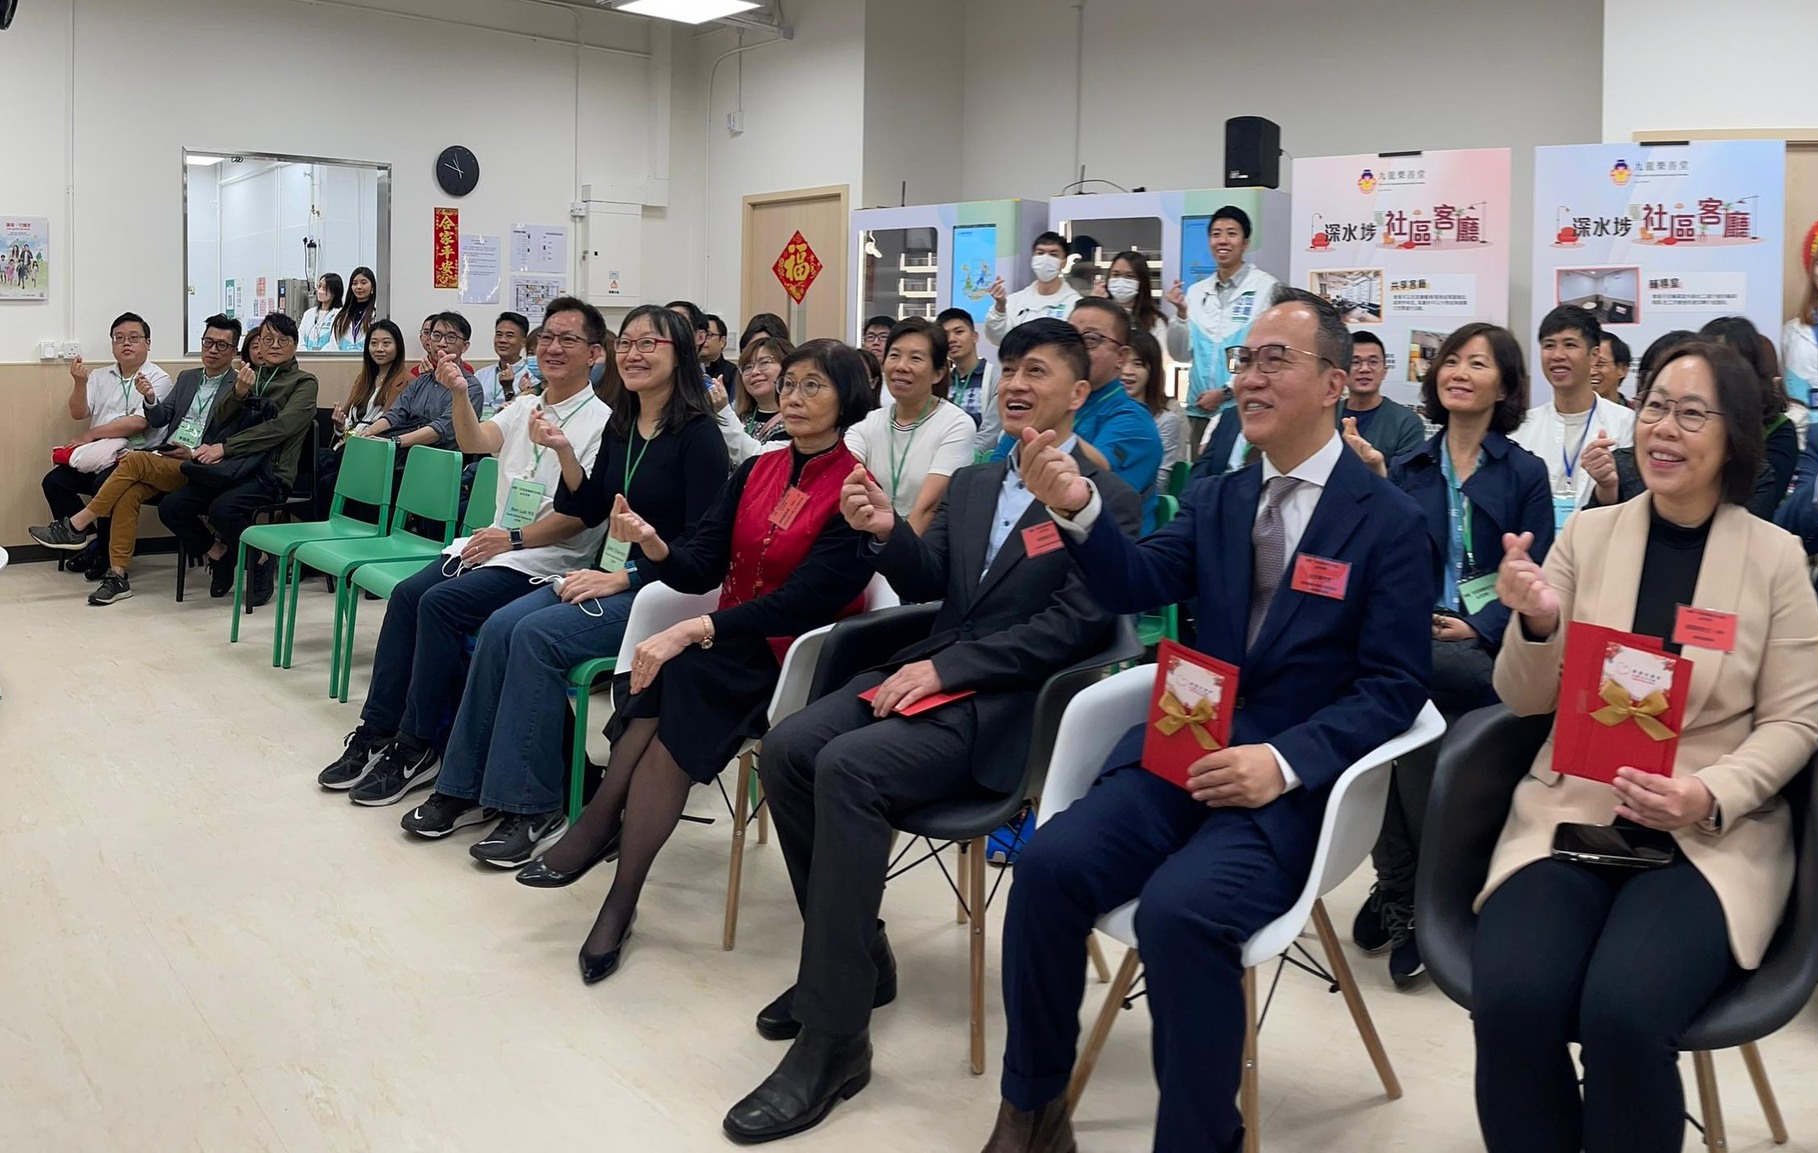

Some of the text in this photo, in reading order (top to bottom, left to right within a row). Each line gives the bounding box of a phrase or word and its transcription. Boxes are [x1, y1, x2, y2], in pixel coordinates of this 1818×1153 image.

[1324, 204, 1479, 246] 深水埗 社區客廳
[1573, 198, 1750, 242] 深水埗 社區客廳
[439, 215, 455, 276] 合家平安
[784, 243, 811, 281] 福
